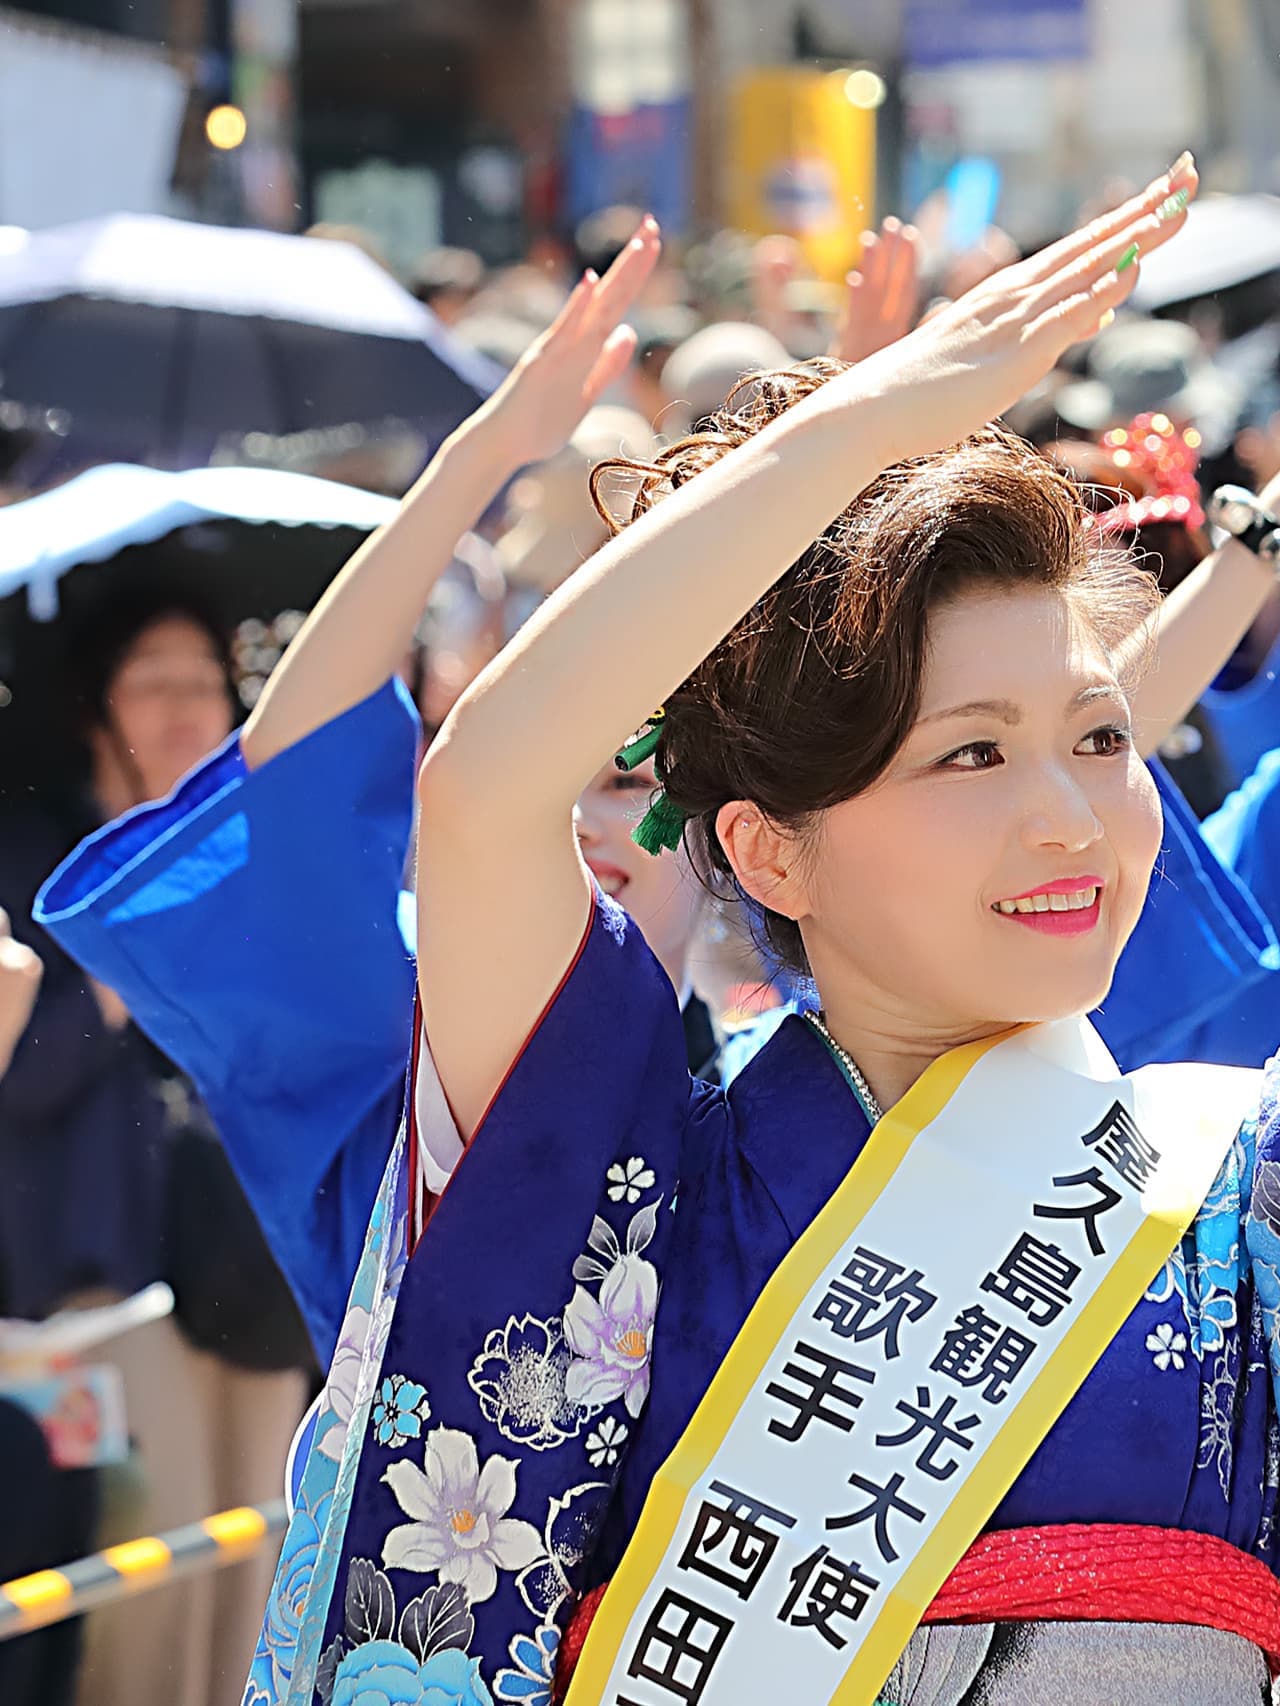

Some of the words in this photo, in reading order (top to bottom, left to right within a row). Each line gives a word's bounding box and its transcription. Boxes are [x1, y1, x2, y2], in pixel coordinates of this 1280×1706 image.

[765, 1246, 938, 1443] 歌手
[776, 1100, 1161, 1650] 屋久島観光大使
[615, 1479, 798, 1706] 西田
